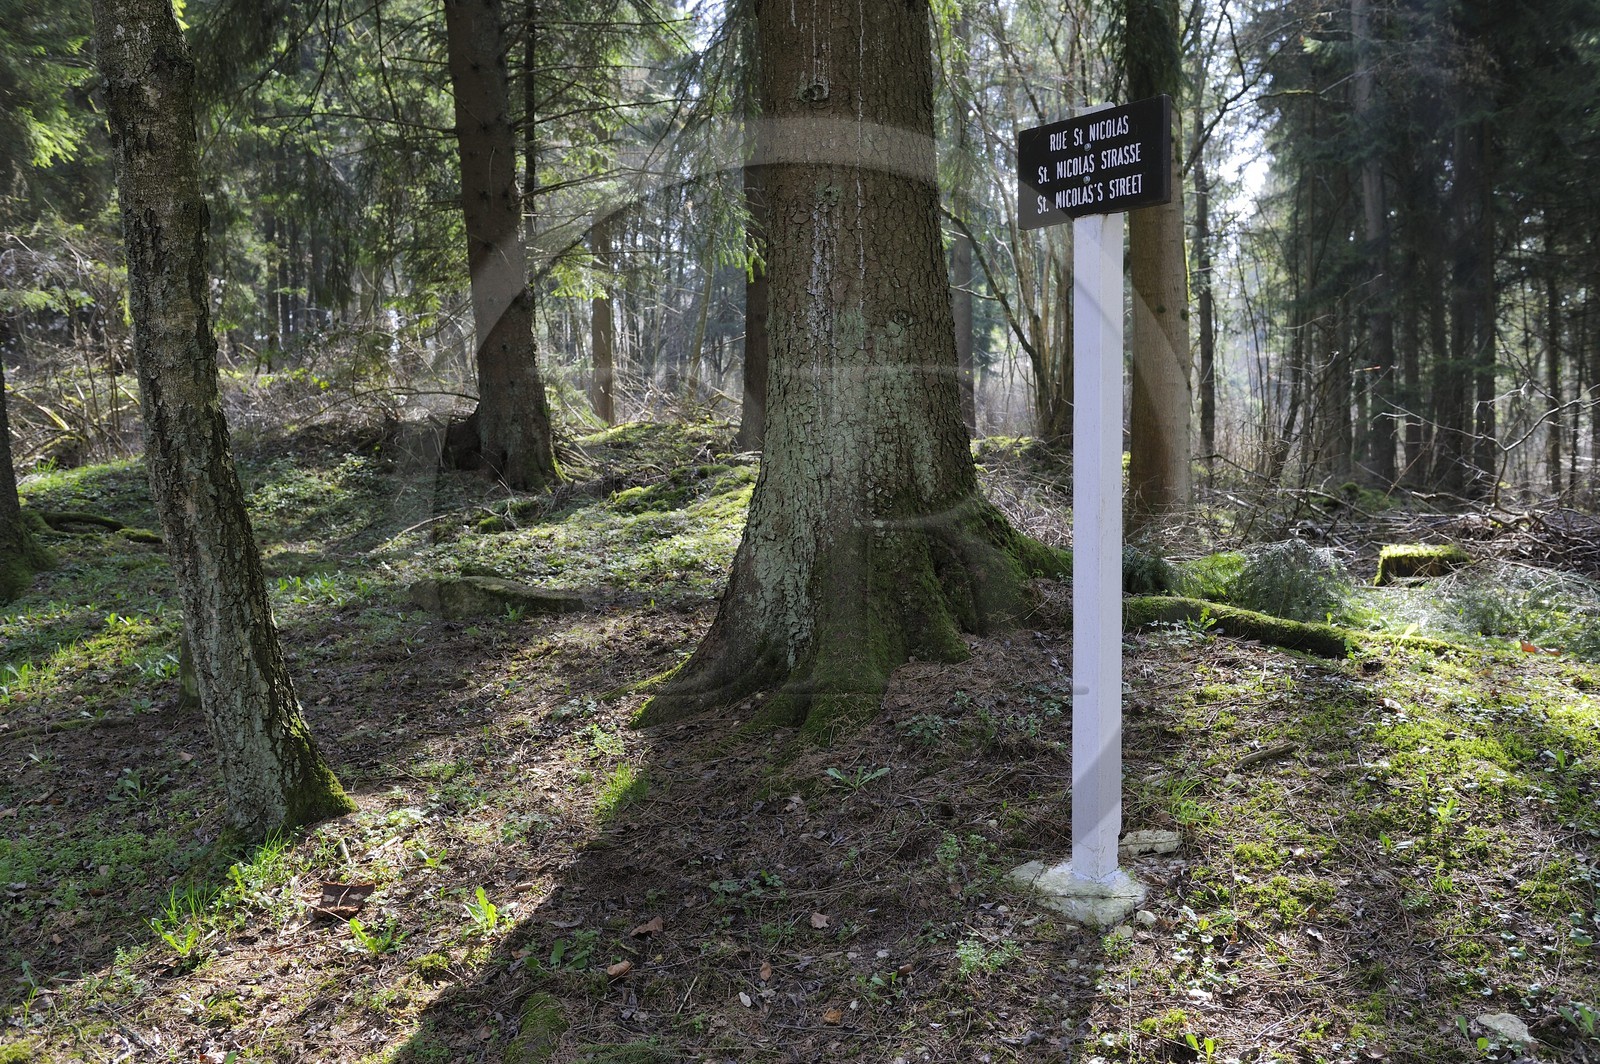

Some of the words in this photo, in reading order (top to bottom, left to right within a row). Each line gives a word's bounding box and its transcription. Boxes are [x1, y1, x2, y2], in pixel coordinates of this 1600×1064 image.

[1049, 130, 1068, 152] RUE
[1073, 127, 1084, 147] St
[1089, 114, 1129, 142] NICOLAS
[1037, 165, 1050, 185] St.
[1056, 153, 1095, 180] NICOLAS
[1100, 142, 1142, 170] STRASSE
[1037, 195, 1050, 215] St.
[1055, 182, 1103, 210] NICOLAS'S
[1109, 173, 1143, 199] STREET
